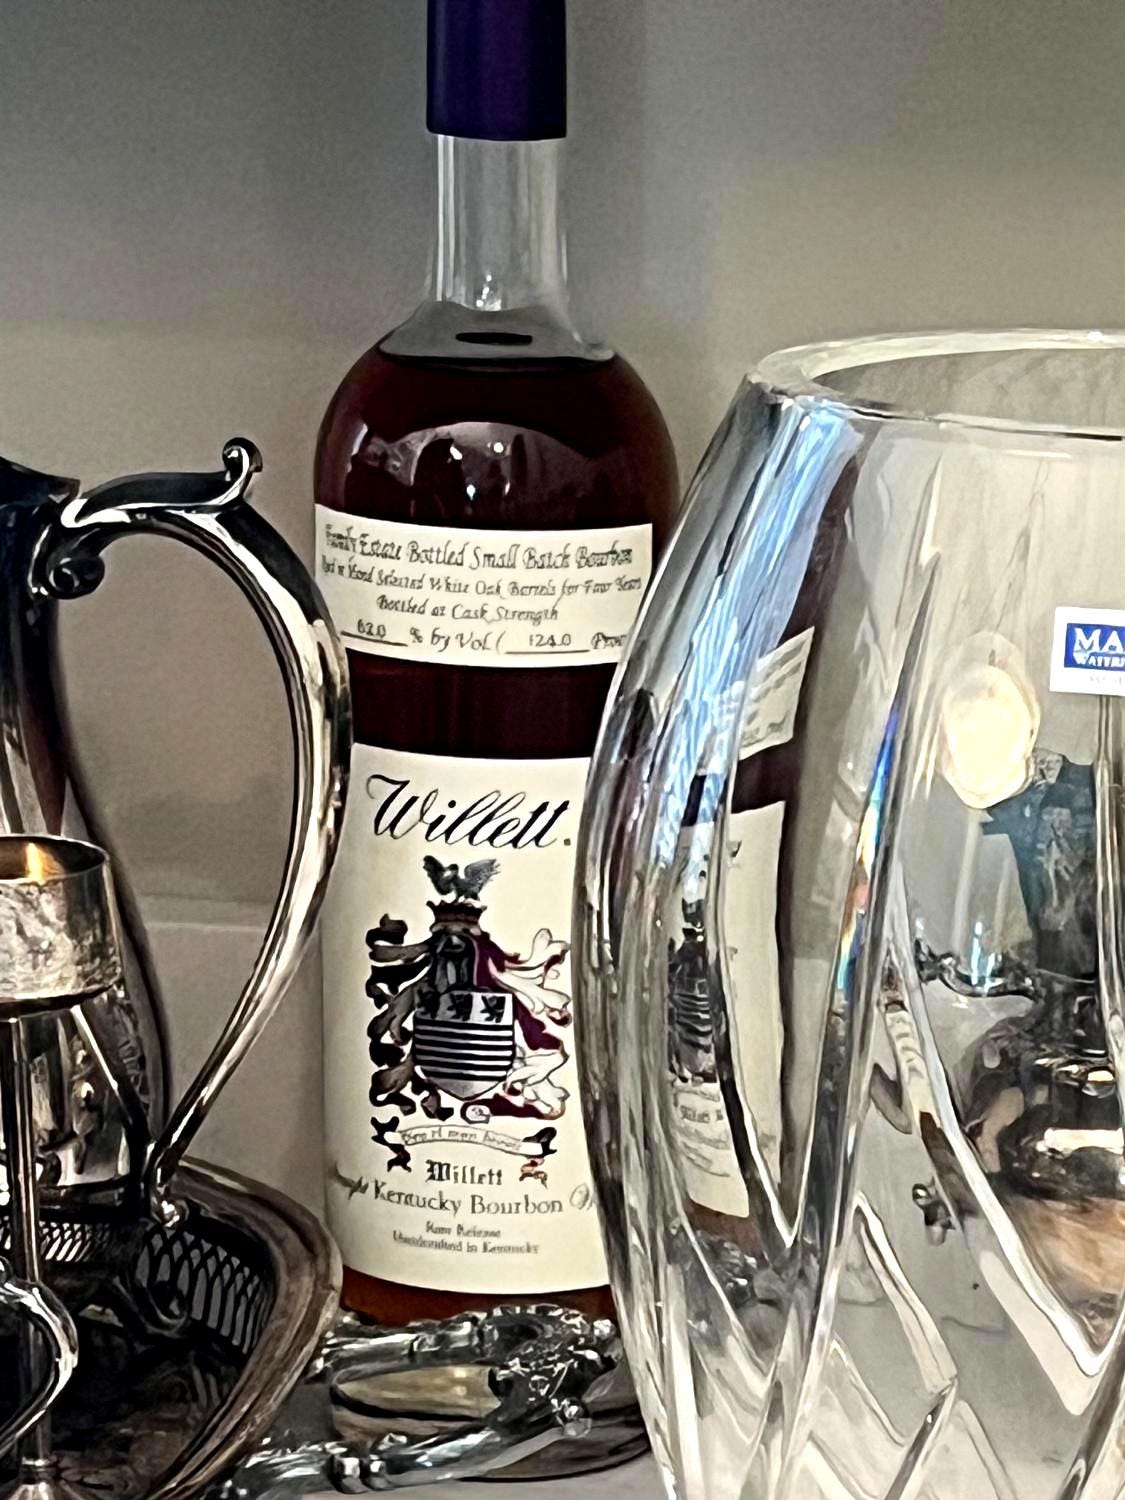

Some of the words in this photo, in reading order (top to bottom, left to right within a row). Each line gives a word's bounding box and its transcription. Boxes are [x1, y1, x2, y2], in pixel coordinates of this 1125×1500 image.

[407, 540, 469, 566] Bottled
[469, 544, 520, 569] Small
[522, 543, 571, 569] Batch
[475, 579, 505, 599] Oak
[452, 602, 489, 623] Cask
[496, 605, 559, 626] Strength
[430, 627, 451, 653] by
[425, 1159, 502, 1186] Willett
[375, 1178, 462, 1218] Kentucky
[470, 1193, 563, 1215] Bourbon
